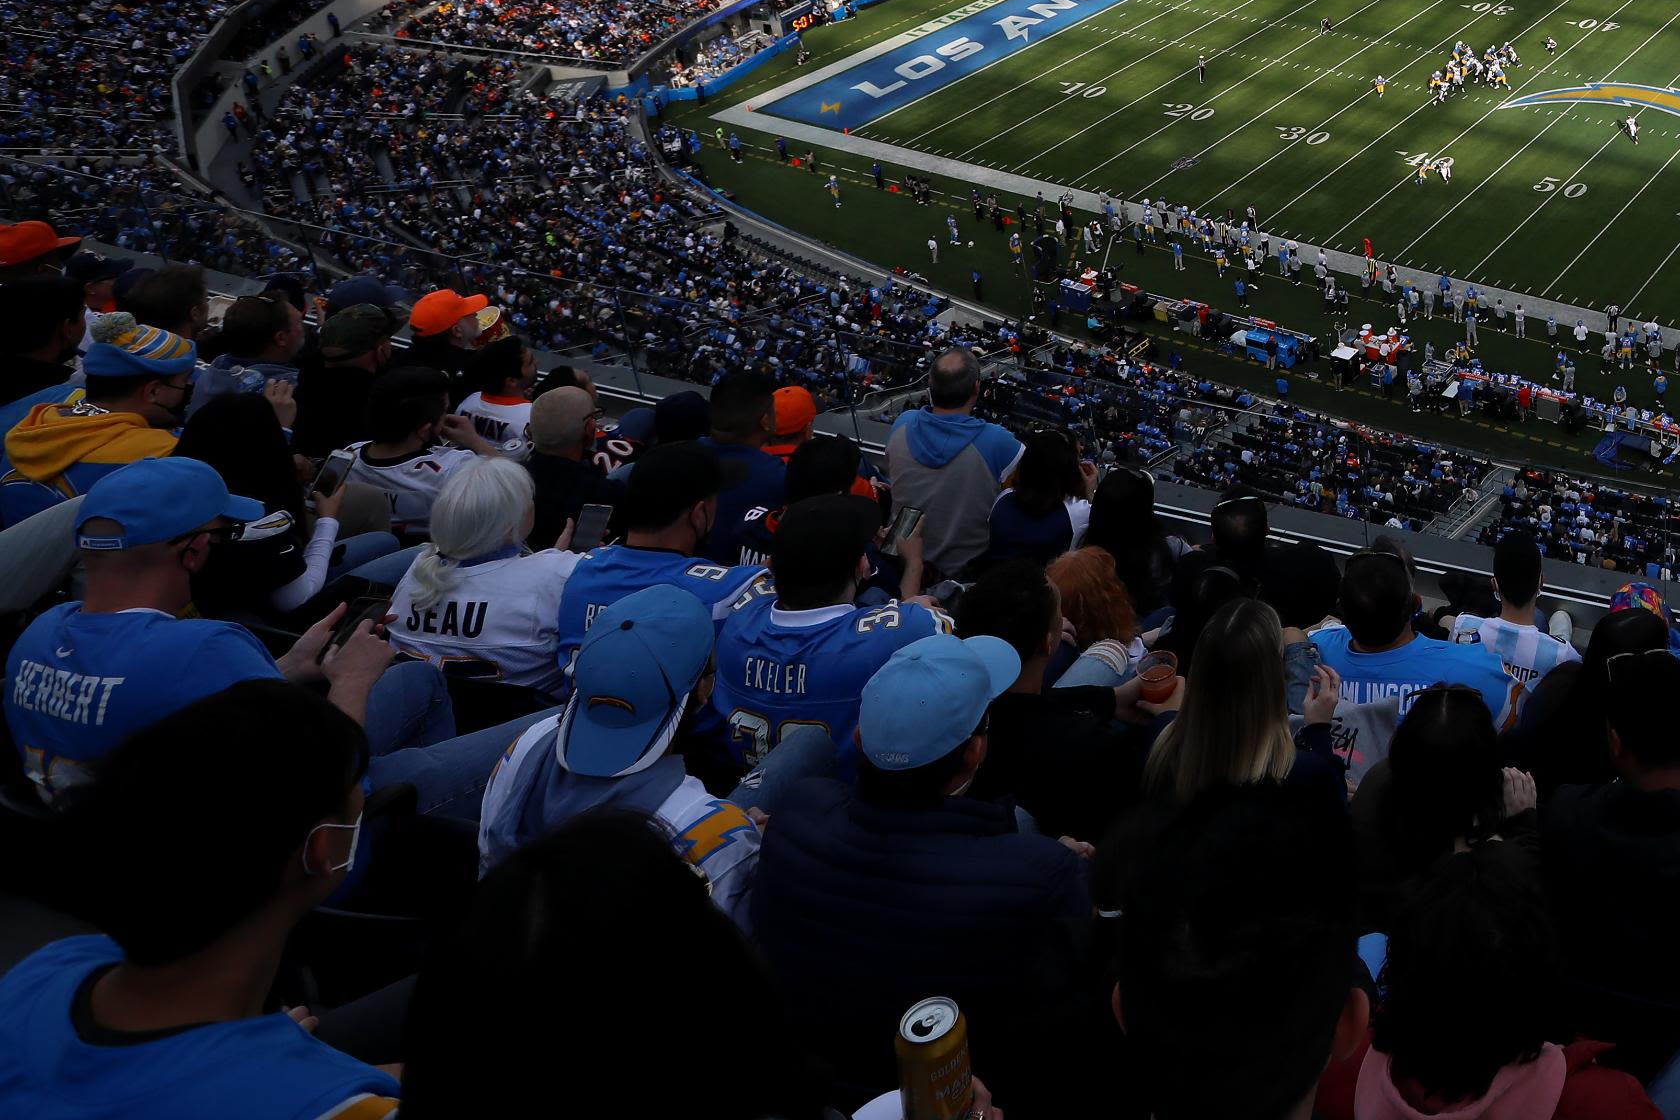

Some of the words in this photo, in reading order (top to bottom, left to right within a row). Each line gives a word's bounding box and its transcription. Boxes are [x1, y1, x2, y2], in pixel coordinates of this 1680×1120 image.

[793, 14, 813, 32] 5:01
[905, 22, 931, 38] IT
[850, 35, 985, 99] LOS
[1067, 81, 1108, 100] 10
[1171, 103, 1216, 122] 20
[1280, 127, 1331, 146] 30
[1532, 175, 1589, 199] 50
[406, 600, 489, 638] SEAU
[745, 656, 807, 696] EKELER
[13, 659, 126, 726] HERBERT
